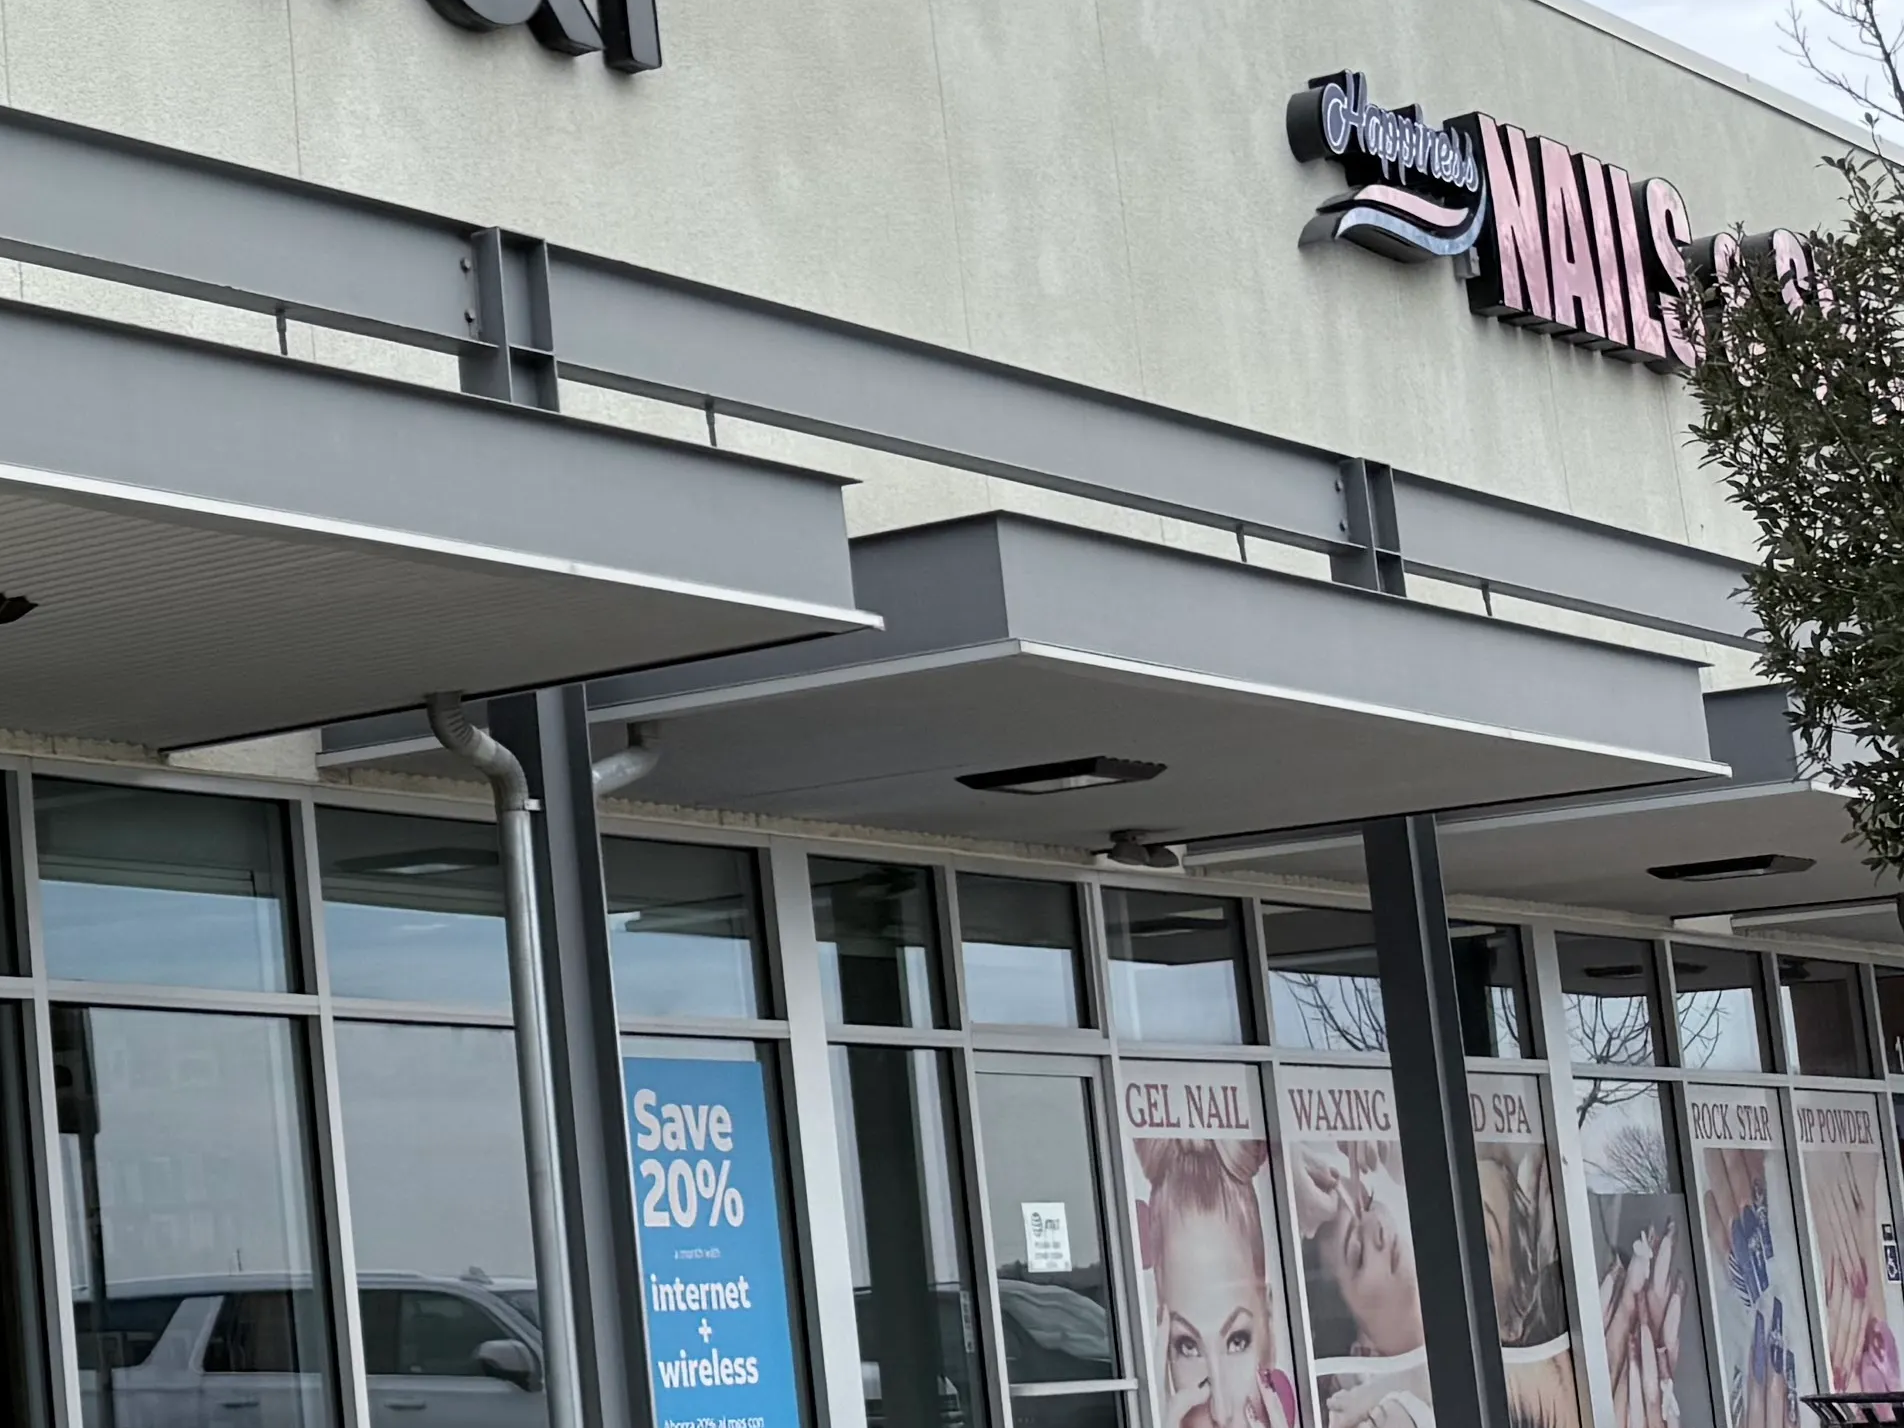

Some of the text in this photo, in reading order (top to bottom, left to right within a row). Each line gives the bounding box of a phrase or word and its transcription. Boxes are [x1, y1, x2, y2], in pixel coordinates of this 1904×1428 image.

[1307, 69, 1479, 192] Happiness
[1460, 112, 1705, 371] NAILS
[634, 1088, 733, 1152] Save
[1125, 1082, 1249, 1130] GEL NAIL
[1287, 1088, 1391, 1132] WAXING
[1492, 1093, 1532, 1134] SPA
[1691, 1102, 1773, 1142] ROCK STAR
[1816, 1108, 1874, 1145] POWDER
[640, 1158, 744, 1228] 20%
[650, 1273, 752, 1312] internet
[698, 1317, 712, 1344] +
[657, 1347, 760, 1389] wireless
